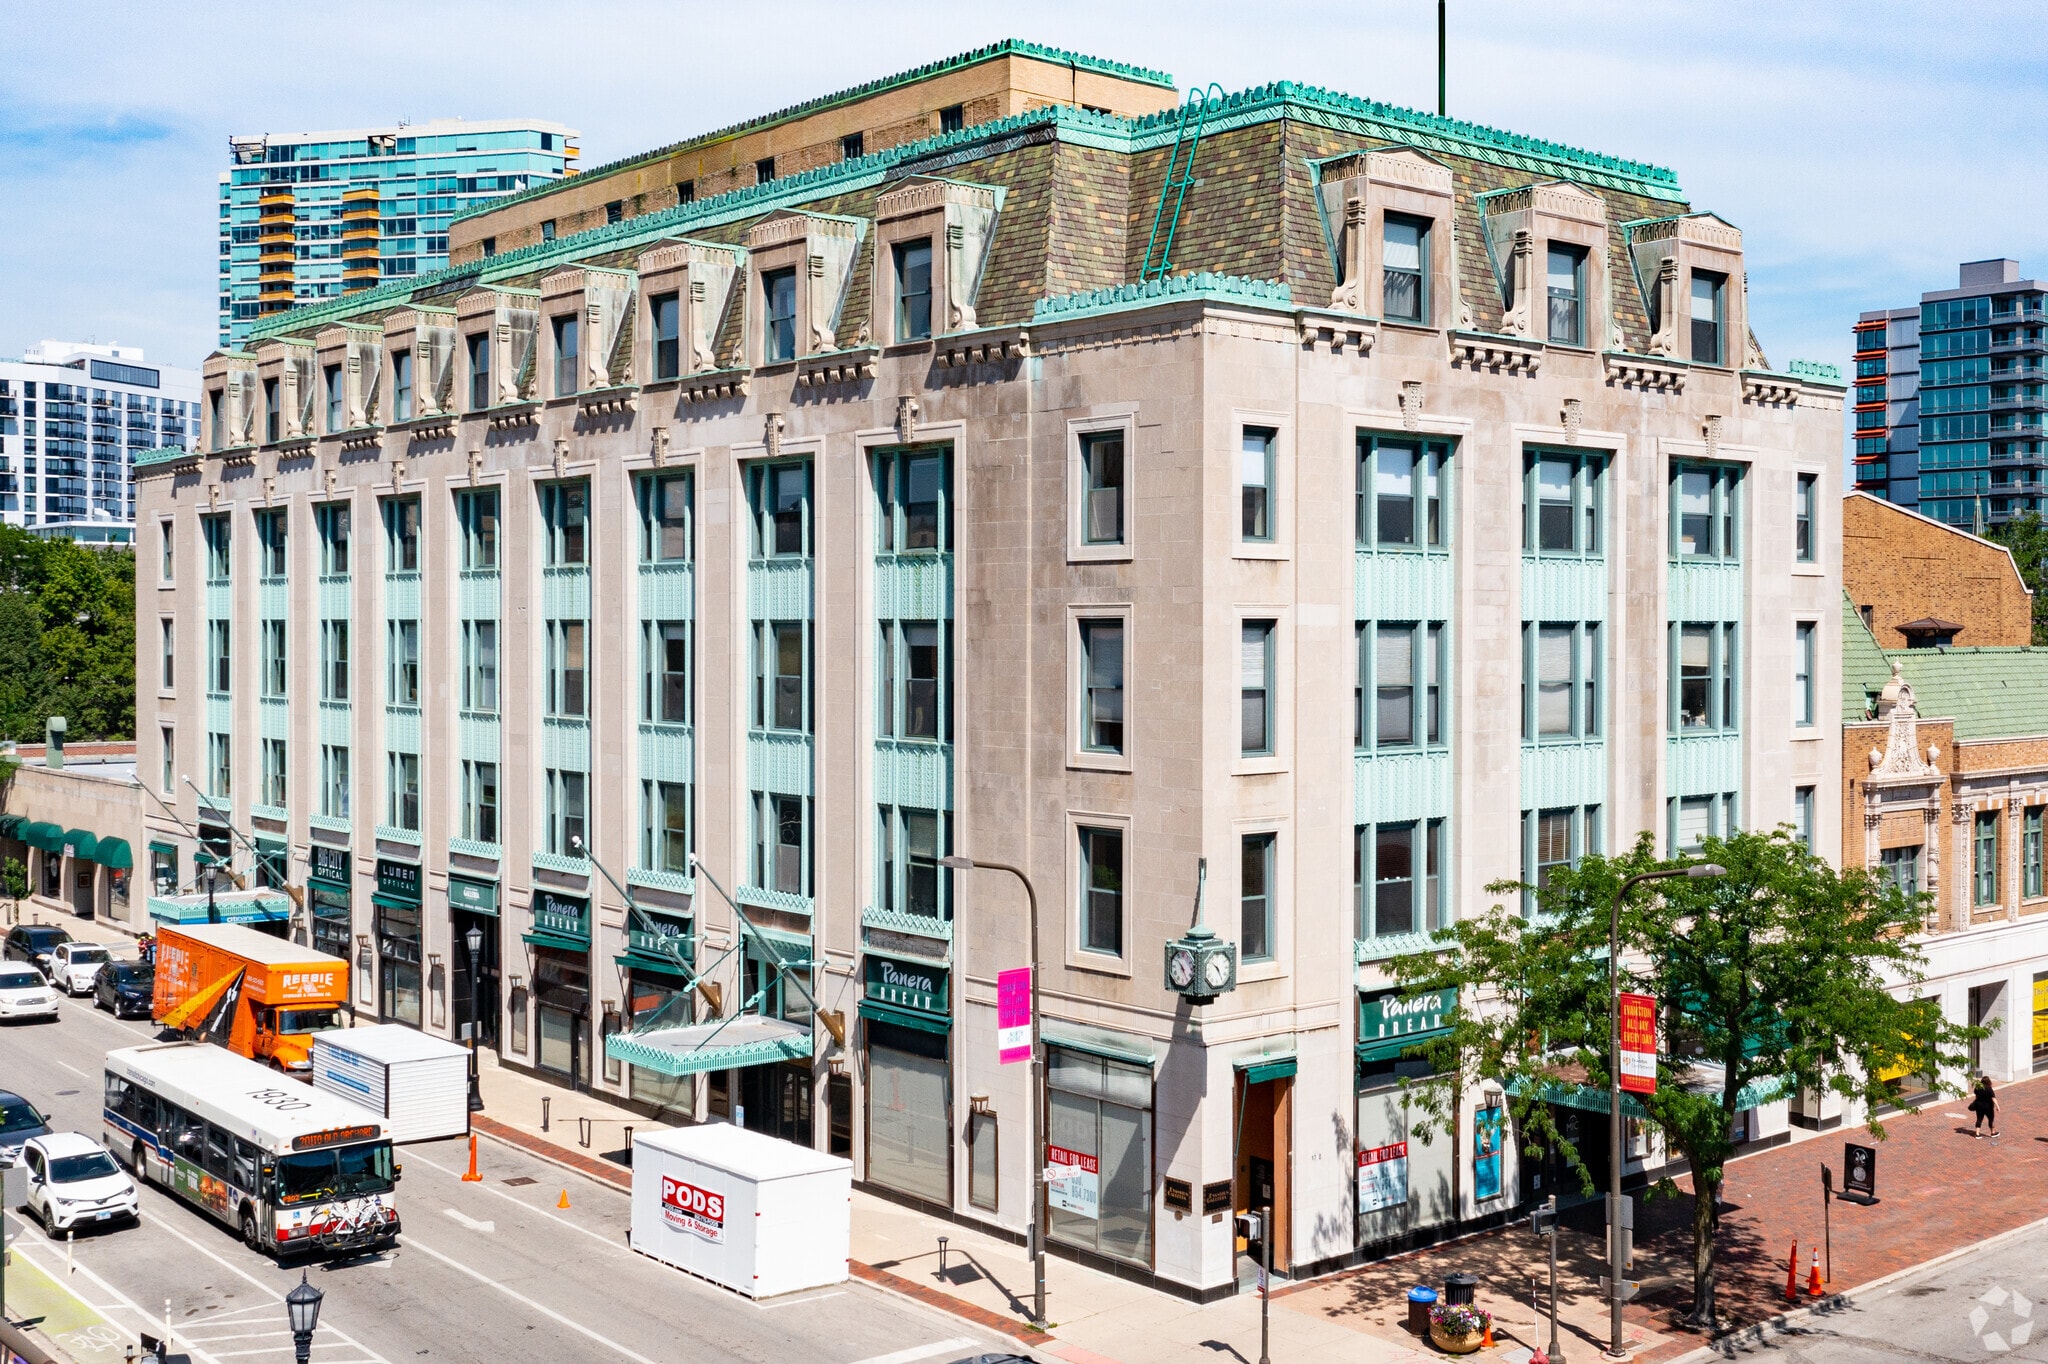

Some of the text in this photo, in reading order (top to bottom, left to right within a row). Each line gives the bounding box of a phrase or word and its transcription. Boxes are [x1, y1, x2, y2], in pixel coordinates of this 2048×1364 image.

[329, 850, 343, 870] CITY
[317, 867, 344, 881] OPTICAL
[382, 864, 415, 881] LUMEN
[382, 877, 415, 891] OPTICAL
[545, 894, 578, 918] Panera
[544, 915, 578, 932] BREAD
[283, 973, 333, 988] REEBIE
[880, 961, 932, 992] Panera
[880, 986, 932, 1010] BREAD
[1378, 993, 1442, 1019] Panera
[1623, 1004, 1652, 1018] EVANSTON
[1379, 1014, 1441, 1038] BREAD
[1623, 1031, 1653, 1045] EVERY DAY
[245, 1087, 313, 1111] 1930
[1051, 1148, 1097, 1172] RETAIL FOR LEASE
[662, 1178, 723, 1218] PODS
[664, 1210, 718, 1238] Moving & Storage
